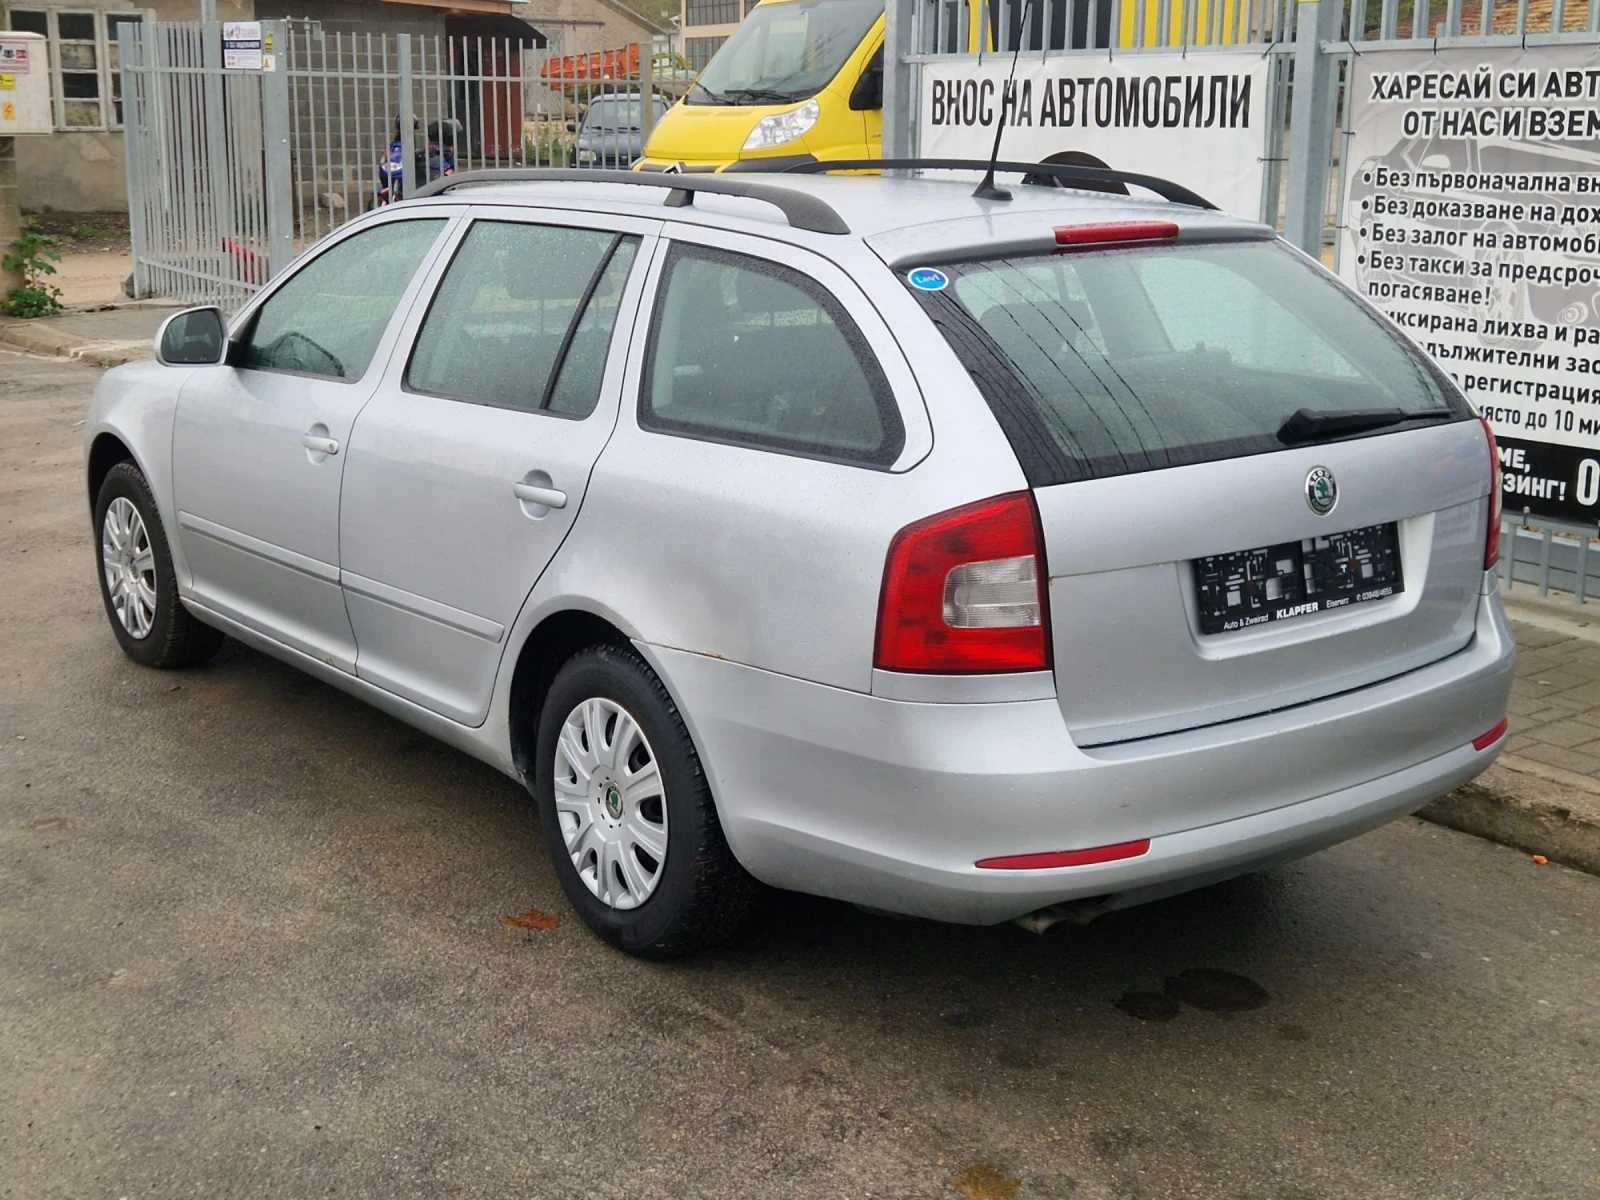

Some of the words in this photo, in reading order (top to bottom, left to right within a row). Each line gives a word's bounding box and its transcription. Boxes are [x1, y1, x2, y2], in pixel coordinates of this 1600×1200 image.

[1371, 67, 1491, 100] ХАРЕСАЙ
[1499, 72, 1536, 99] СИ
[1542, 71, 1600, 98] АВТ
[931, 79, 994, 126] ВНОС
[1001, 79, 1032, 127] НА
[1039, 75, 1251, 128] АВТОМОБИЛИ
[1403, 111, 1436, 136] ОТ
[1442, 110, 1496, 136] НАС
[1502, 110, 1522, 136] И
[1529, 110, 1600, 136] ВЗЕМ
[1376, 167, 1410, 187] Без
[1415, 172, 1570, 192] първоначална
[1374, 195, 1408, 215] Без
[1412, 200, 1524, 220] доказване
[1530, 205, 1556, 222] на
[1560, 206, 1600, 226] дох
[1372, 223, 1405, 243] Без
[1411, 228, 1468, 246] залог
[1473, 232, 1497, 248] на
[1502, 233, 1600, 254] автомоб
[1370, 250, 1404, 270] Без
[1410, 256, 1465, 275] такси
[1470, 260, 1492, 277] за
[1368, 280, 1491, 306] погасяване!
[1482, 319, 1548, 340] лихва
[1555, 326, 1568, 341] и
[1574, 328, 1600, 348] ра
[1420, 341, 1560, 370] дължителни
[1565, 356, 1600, 375] зас
[1525, 411, 1547, 431] до
[1555, 409, 1574, 432] 10
[1501, 472, 1567, 501] ЗИНГ!
[1224, 619, 1239, 630] Auto
[1245, 613, 1268, 625] Zweirad
[1276, 603, 1318, 619] KLAPFER
[1326, 597, 1349, 608] Eisenerz
